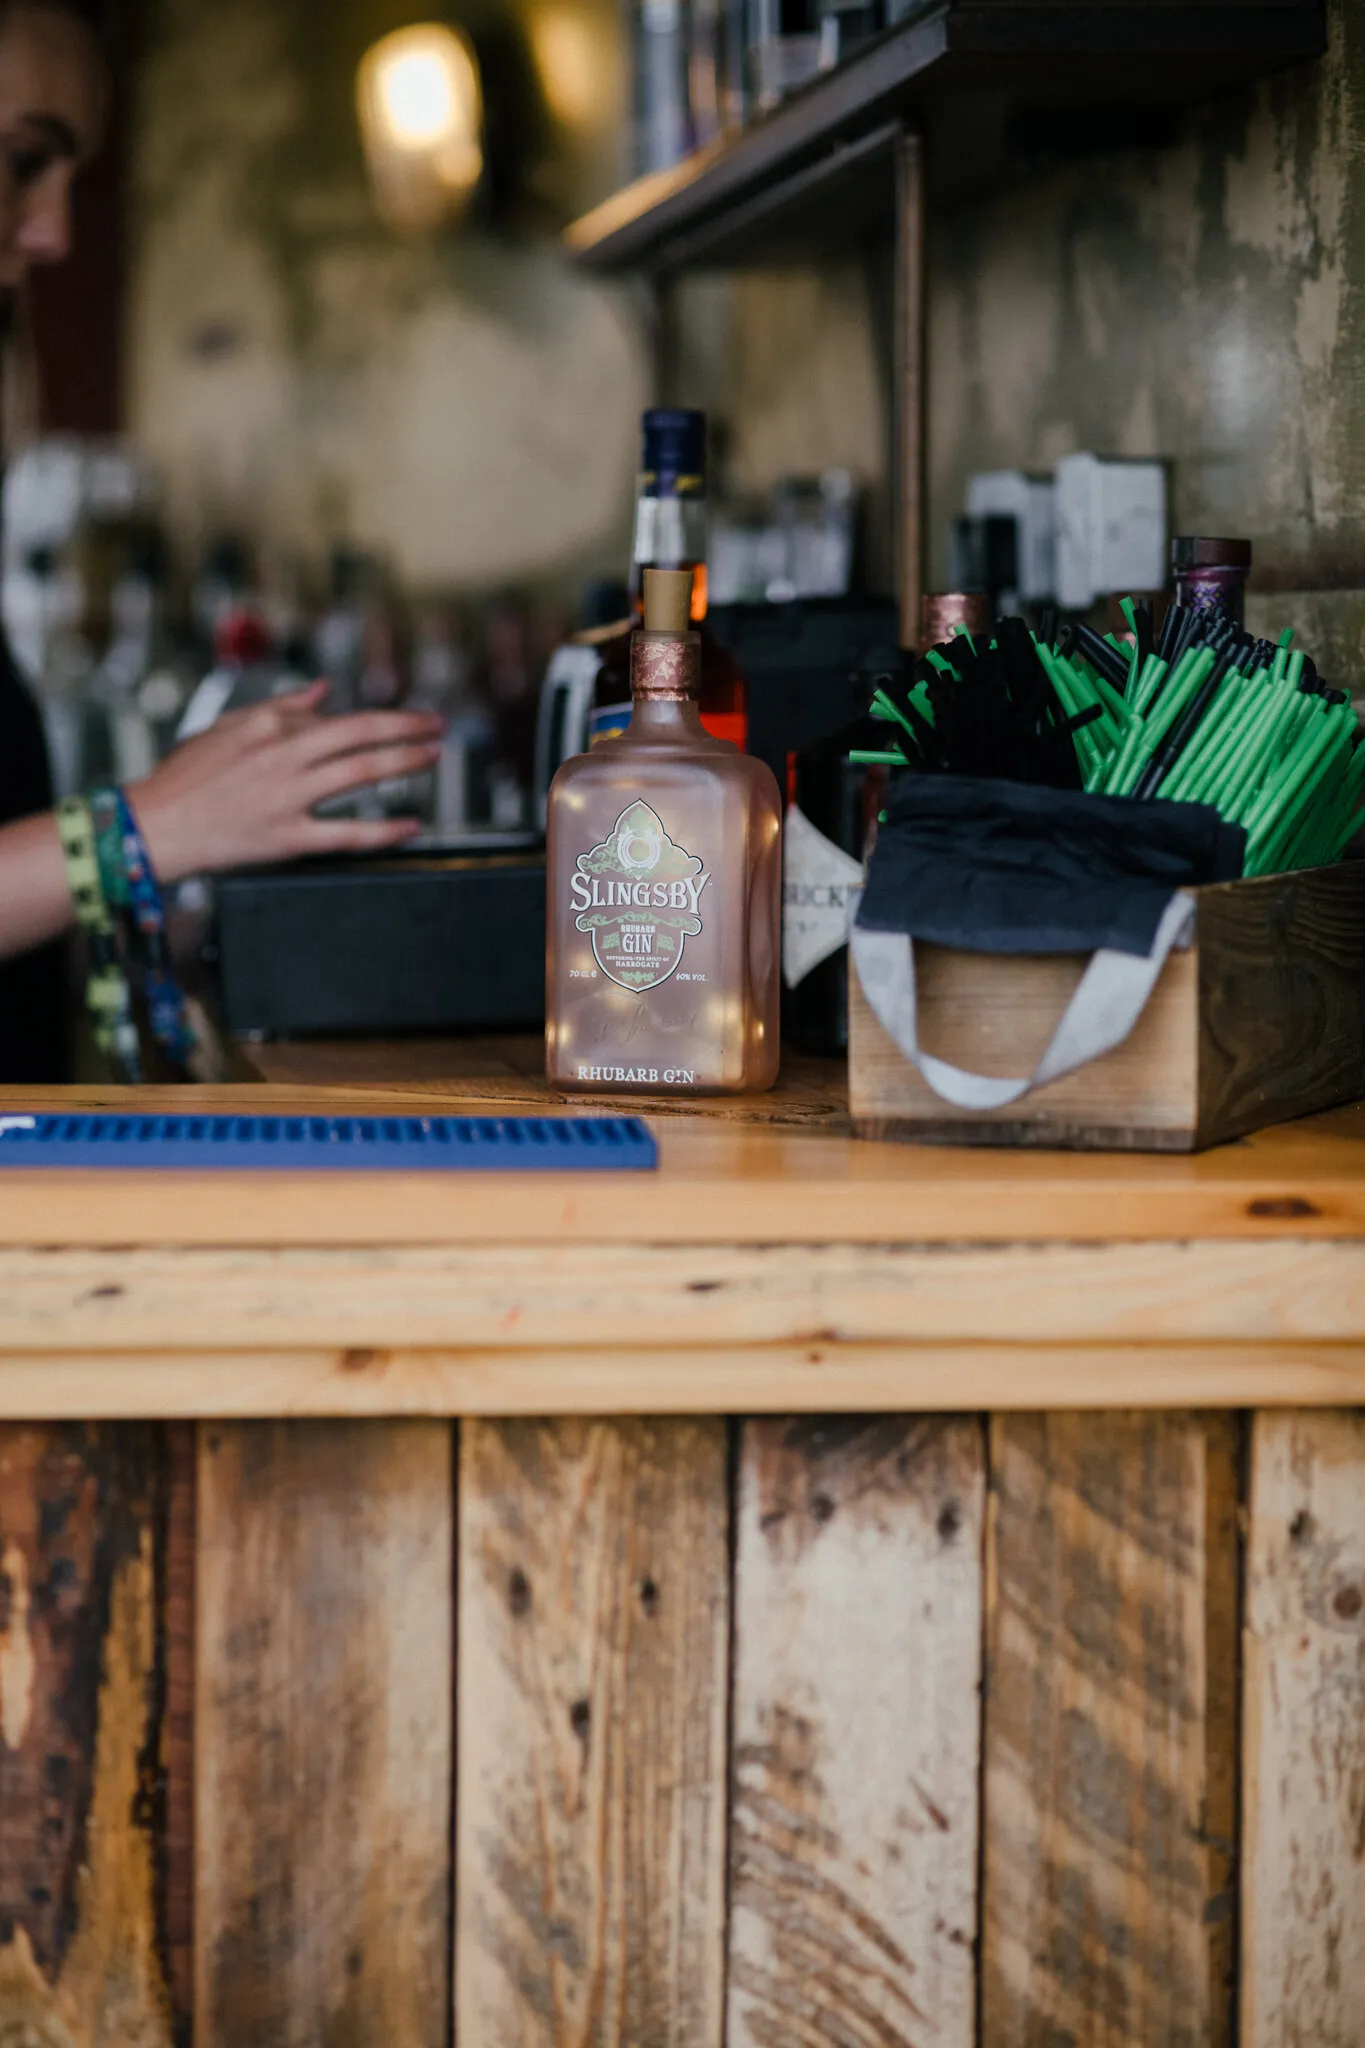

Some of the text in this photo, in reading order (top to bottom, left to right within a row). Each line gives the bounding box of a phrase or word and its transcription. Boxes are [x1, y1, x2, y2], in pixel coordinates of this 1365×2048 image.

[569, 871, 712, 916] SLINGSBY
[620, 924, 656, 933] RHUBARB
[622, 933, 653, 953] GIN
[569, 969, 580, 978] 70
[676, 972, 691, 981] 40%
[577, 1065, 695, 1084] RHUBARB GIN
